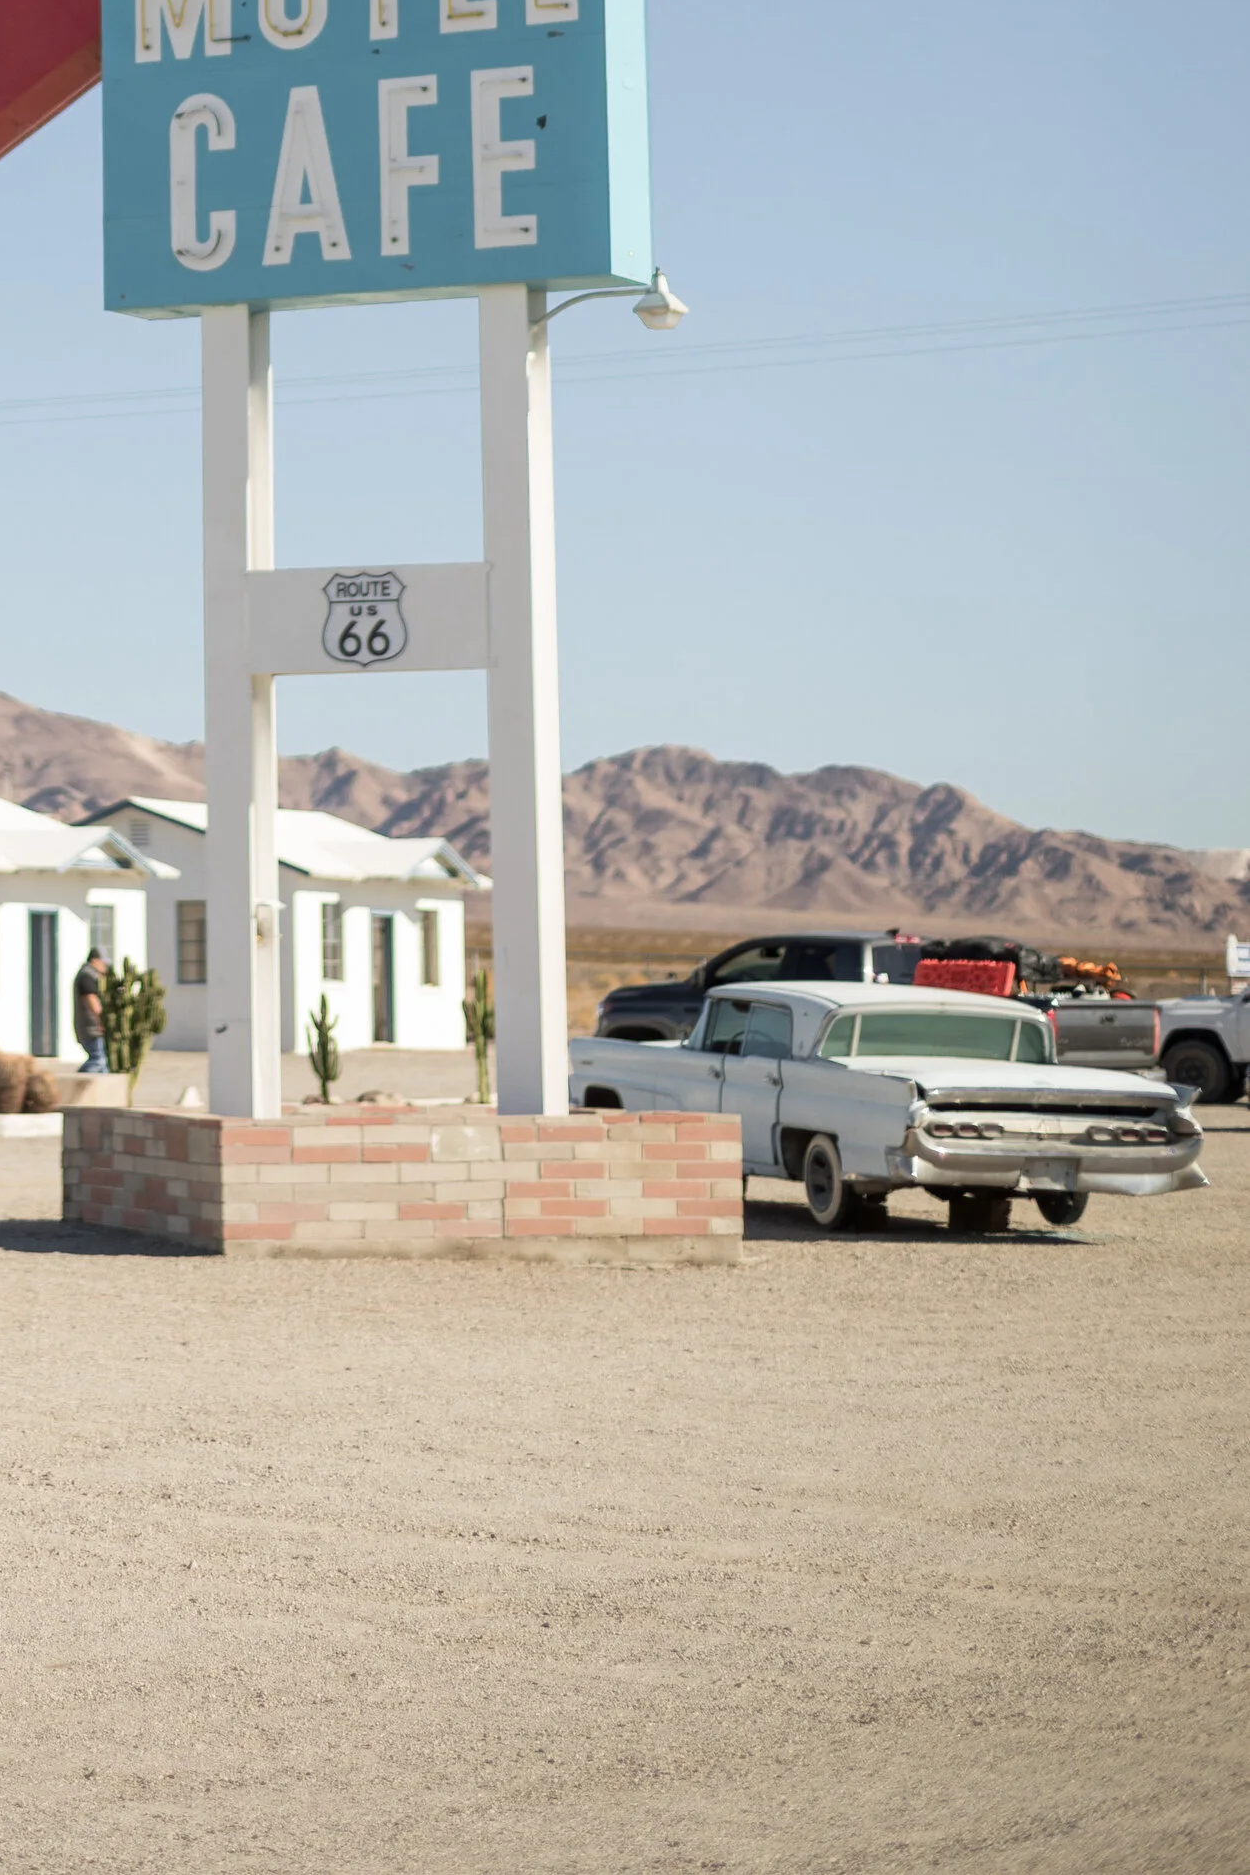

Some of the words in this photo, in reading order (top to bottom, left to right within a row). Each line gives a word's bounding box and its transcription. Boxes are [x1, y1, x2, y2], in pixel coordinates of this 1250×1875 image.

[169, 65, 538, 272] CAFE
[336, 580, 391, 598] ROUTE
[338, 618, 390, 657] 66
